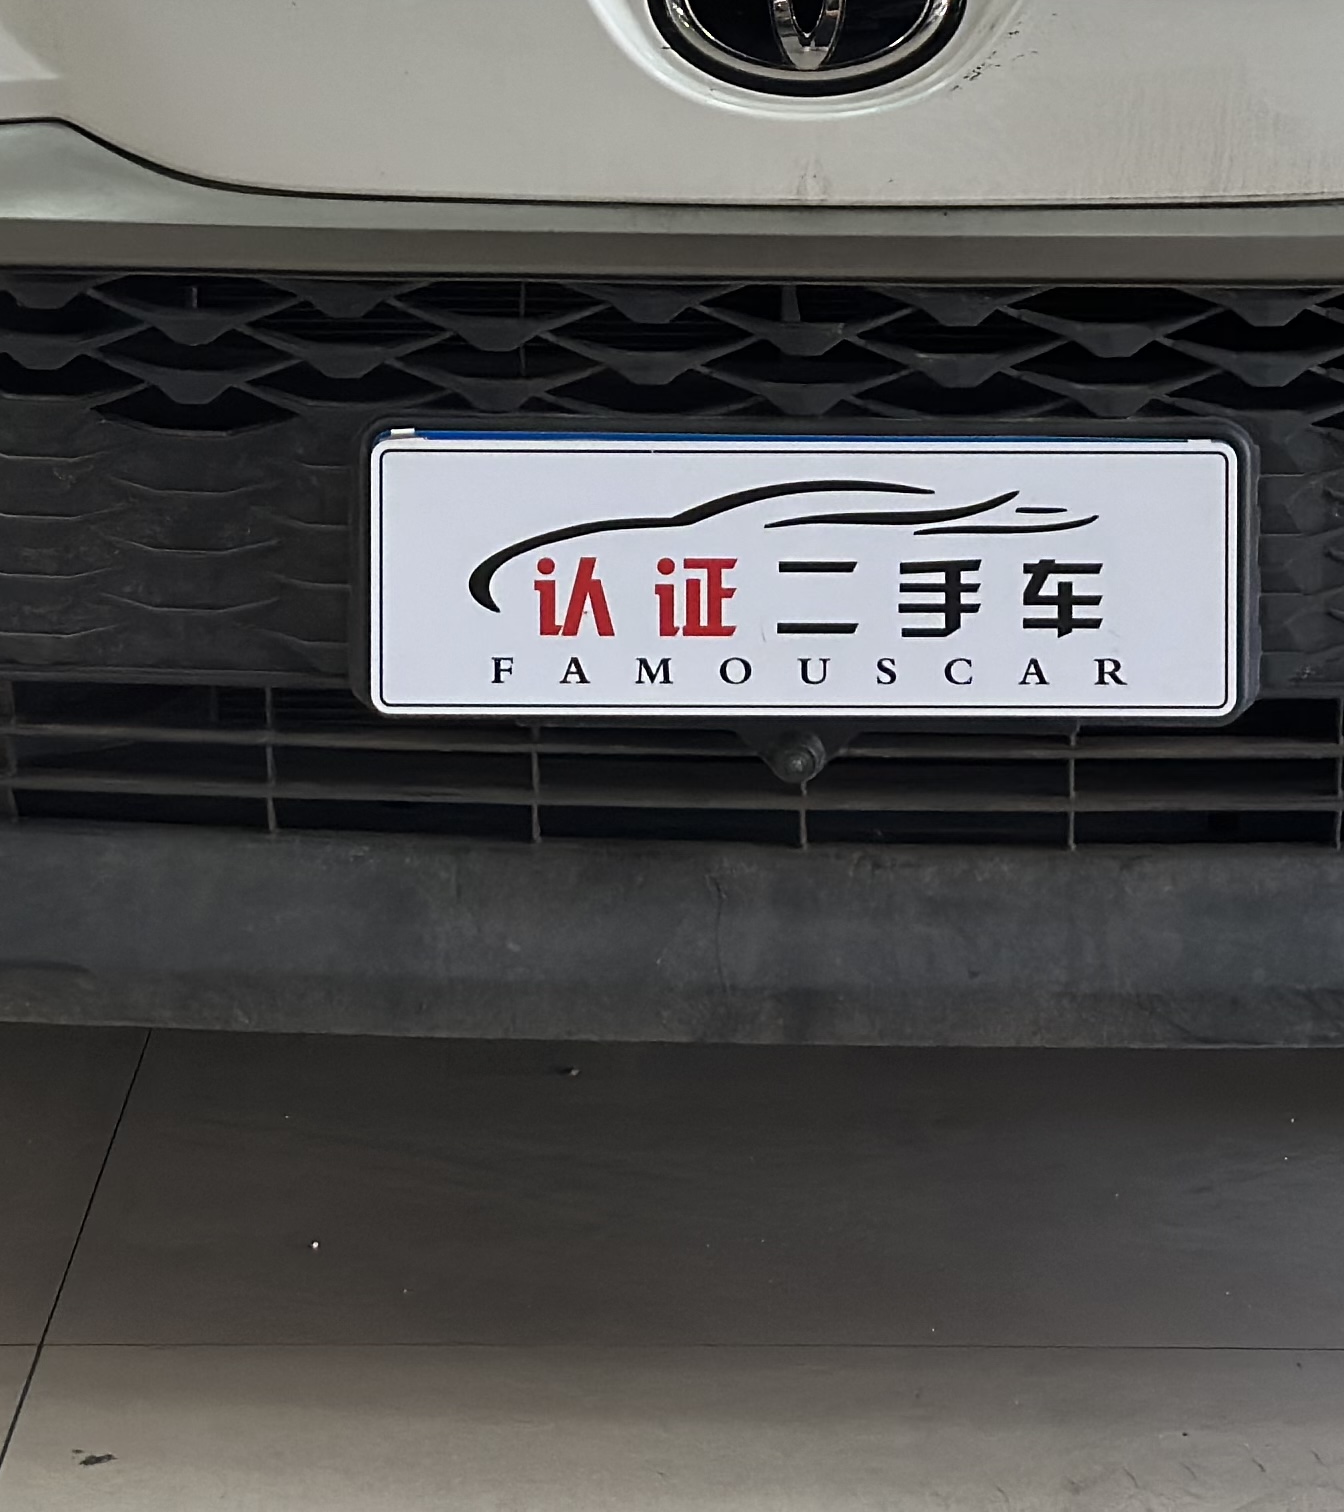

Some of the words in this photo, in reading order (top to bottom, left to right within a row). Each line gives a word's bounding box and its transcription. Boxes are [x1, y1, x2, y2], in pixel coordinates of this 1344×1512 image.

[533, 556, 1105, 638] 认证二手车
[490, 656, 1128, 686] FAMOUSCAR
